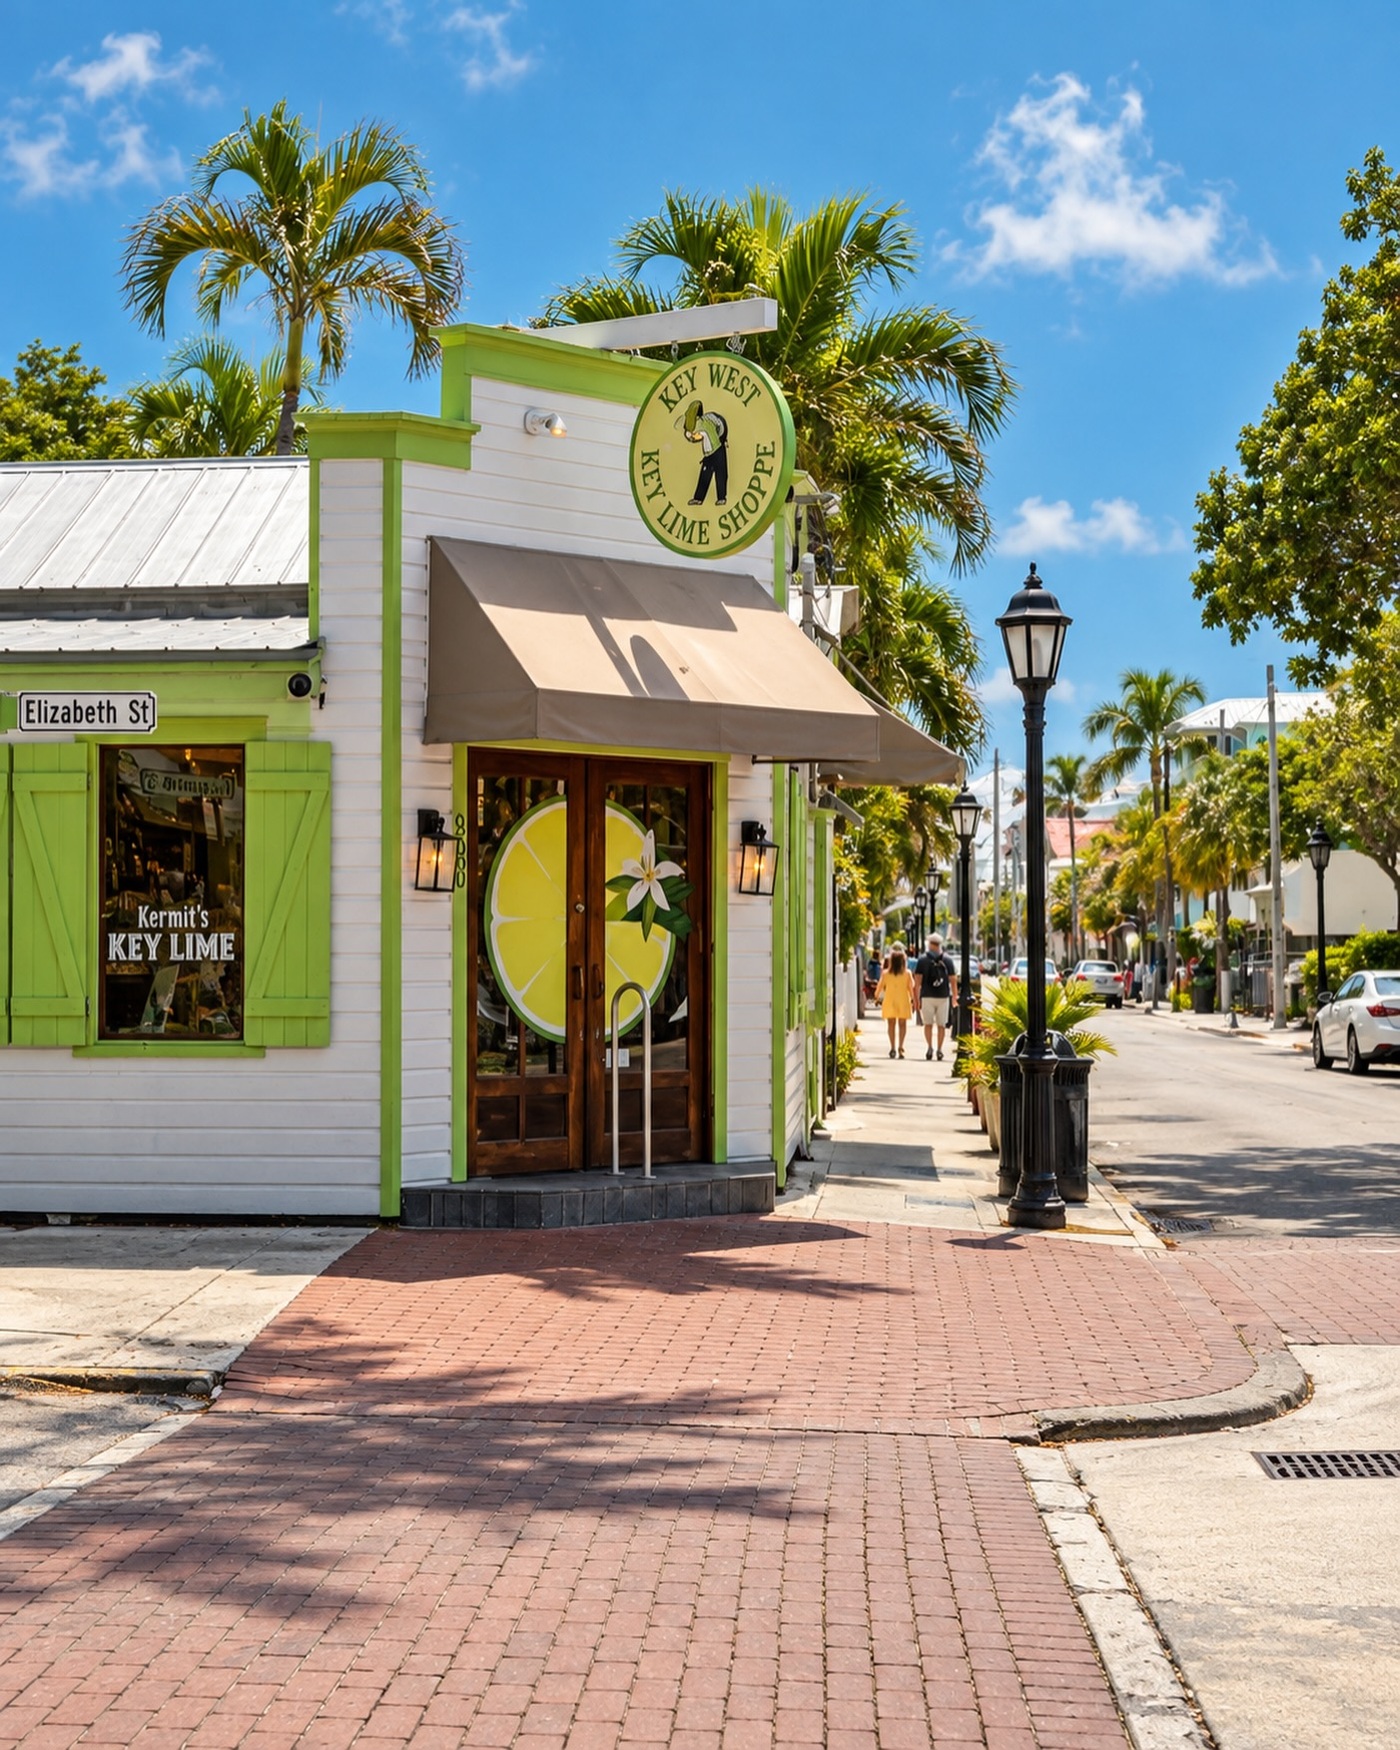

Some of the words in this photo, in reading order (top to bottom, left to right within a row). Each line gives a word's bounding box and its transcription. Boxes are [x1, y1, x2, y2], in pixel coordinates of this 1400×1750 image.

[658, 366, 698, 414] KEY
[708, 363, 761, 408] WEST
[641, 448, 666, 503] KEY
[656, 501, 710, 545] LIME
[718, 440, 775, 540] SHOPPE
[25, 699, 117, 724] Elizabeth
[128, 699, 149, 724] St
[137, 904, 209, 929] Kermit's
[107, 932, 162, 961] KEY
[169, 932, 235, 961] LIME
